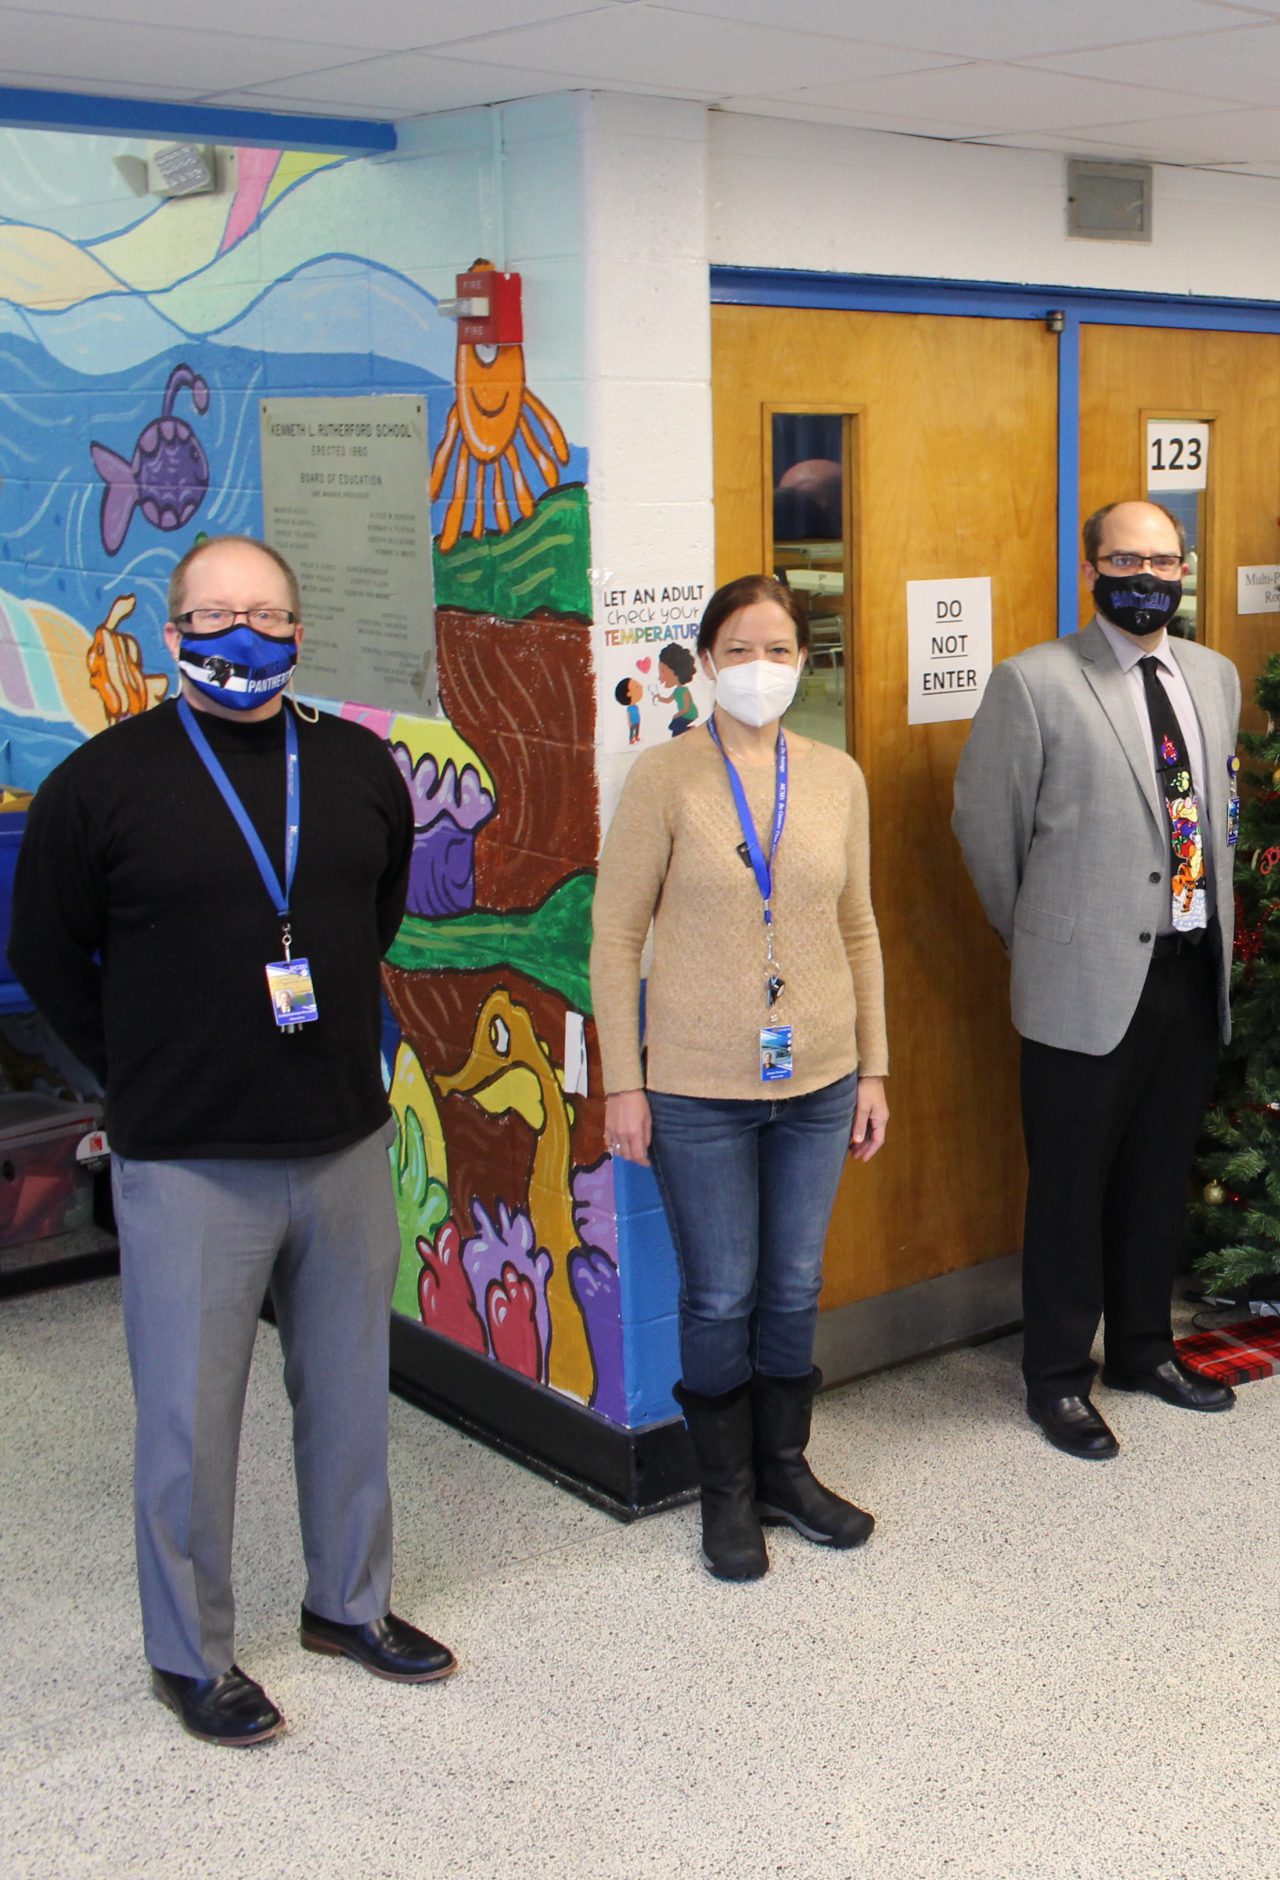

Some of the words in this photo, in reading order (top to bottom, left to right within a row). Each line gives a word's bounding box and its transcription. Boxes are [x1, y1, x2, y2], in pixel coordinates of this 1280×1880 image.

[463, 280, 483, 290] FIRE
[464, 326, 485, 336] FIRE
[271, 423, 306, 437] KENNETH
[318, 423, 372, 438] RUTHERFORD
[376, 423, 412, 438] SCHOOL
[311, 444, 346, 456] ERECTED
[1151, 437, 1202, 470] 123
[301, 472, 324, 484] BOARD
[327, 473, 336, 484] OF
[338, 473, 382, 486] EDUCATION
[604, 590, 626, 607] LET
[633, 588, 655, 604] AN
[661, 585, 704, 603] ADULT
[607, 607, 656, 625] check
[660, 606, 699, 624] your
[937, 600, 962, 619] DO
[605, 623, 700, 647] TEMPERATUR
[931, 634, 968, 655] NOT
[923, 669, 977, 691] ENTER
